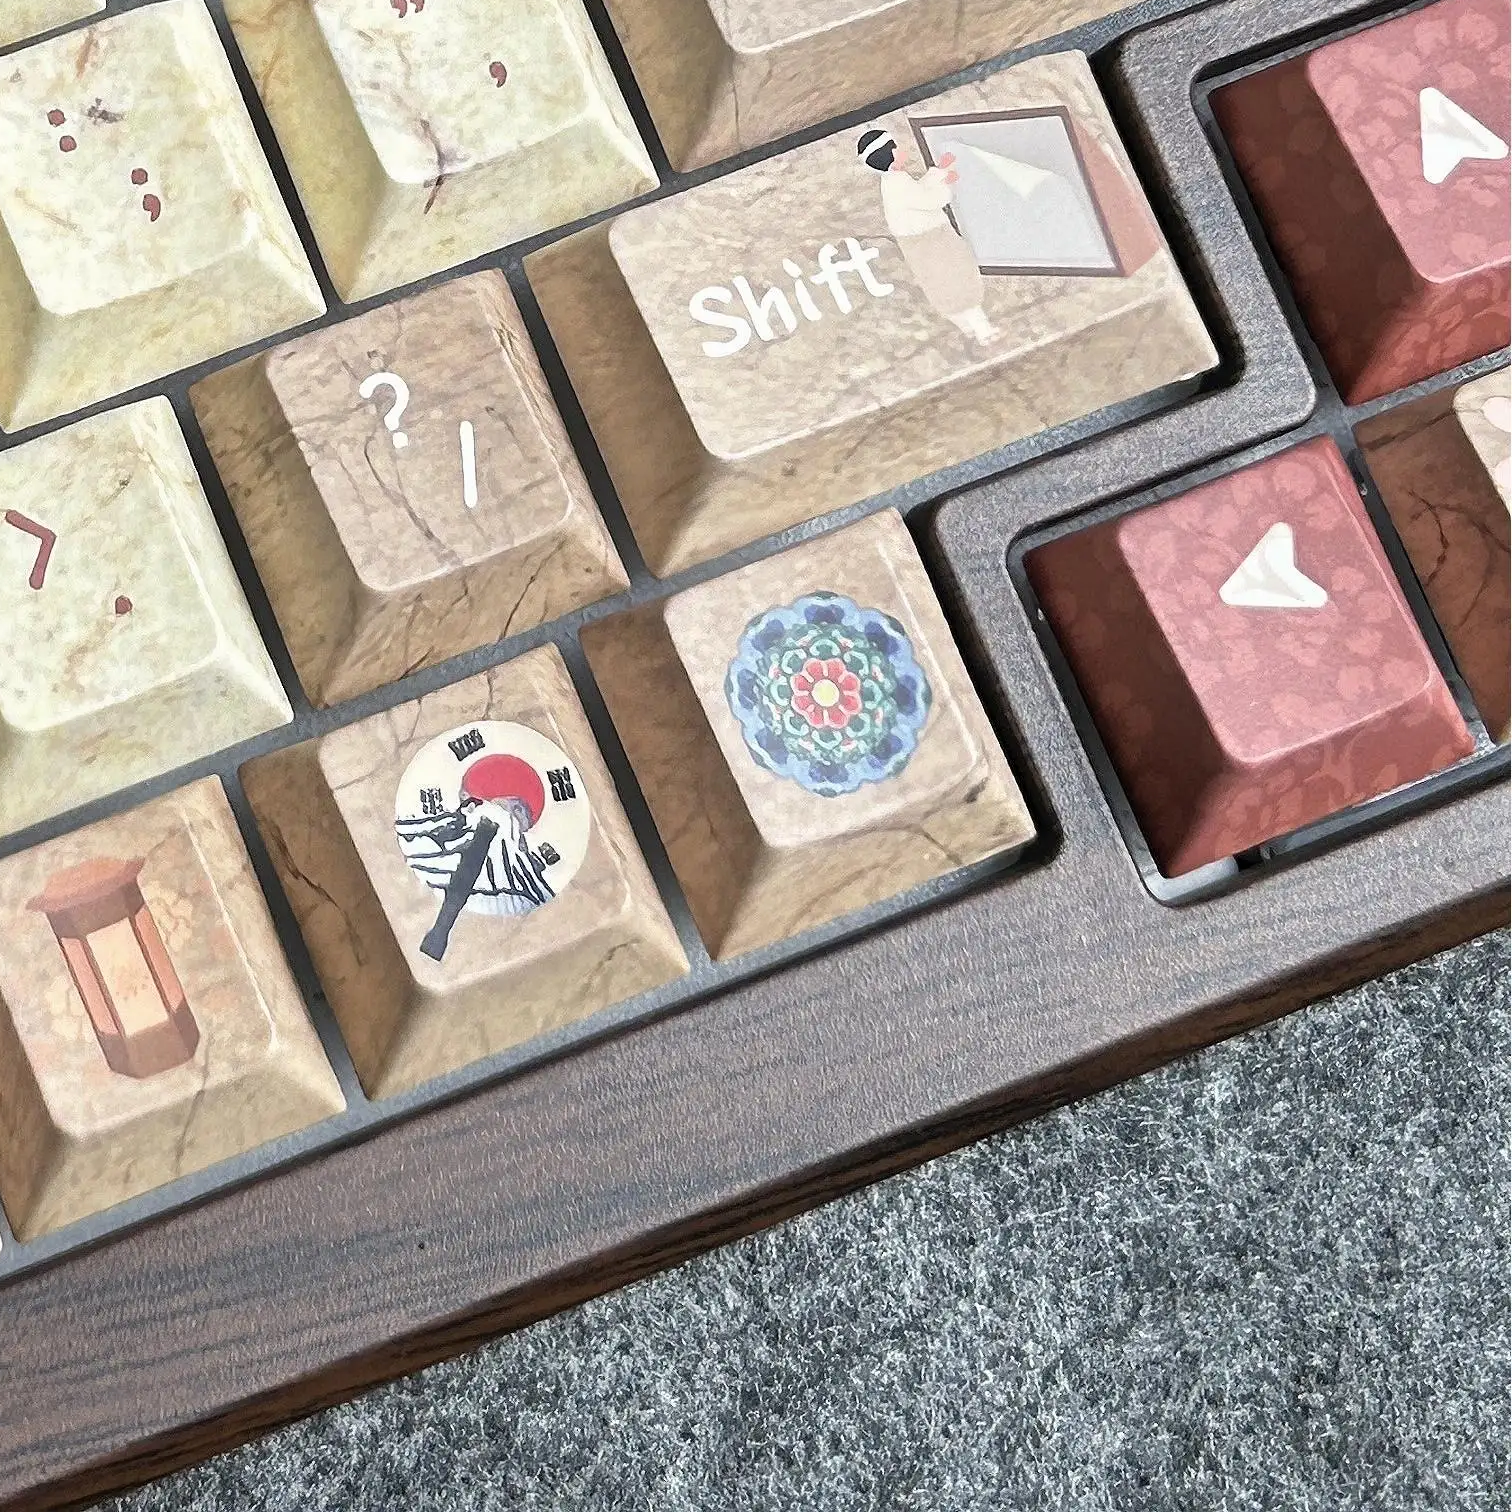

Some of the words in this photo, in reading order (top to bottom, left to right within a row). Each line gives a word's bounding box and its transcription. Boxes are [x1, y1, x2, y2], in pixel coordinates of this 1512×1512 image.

[47, 108, 77, 152] :
[130, 168, 161, 222] ;
[688, 235, 895, 359] Shift
[359, 372, 410, 448] ?
[3, 509, 57, 590] >
